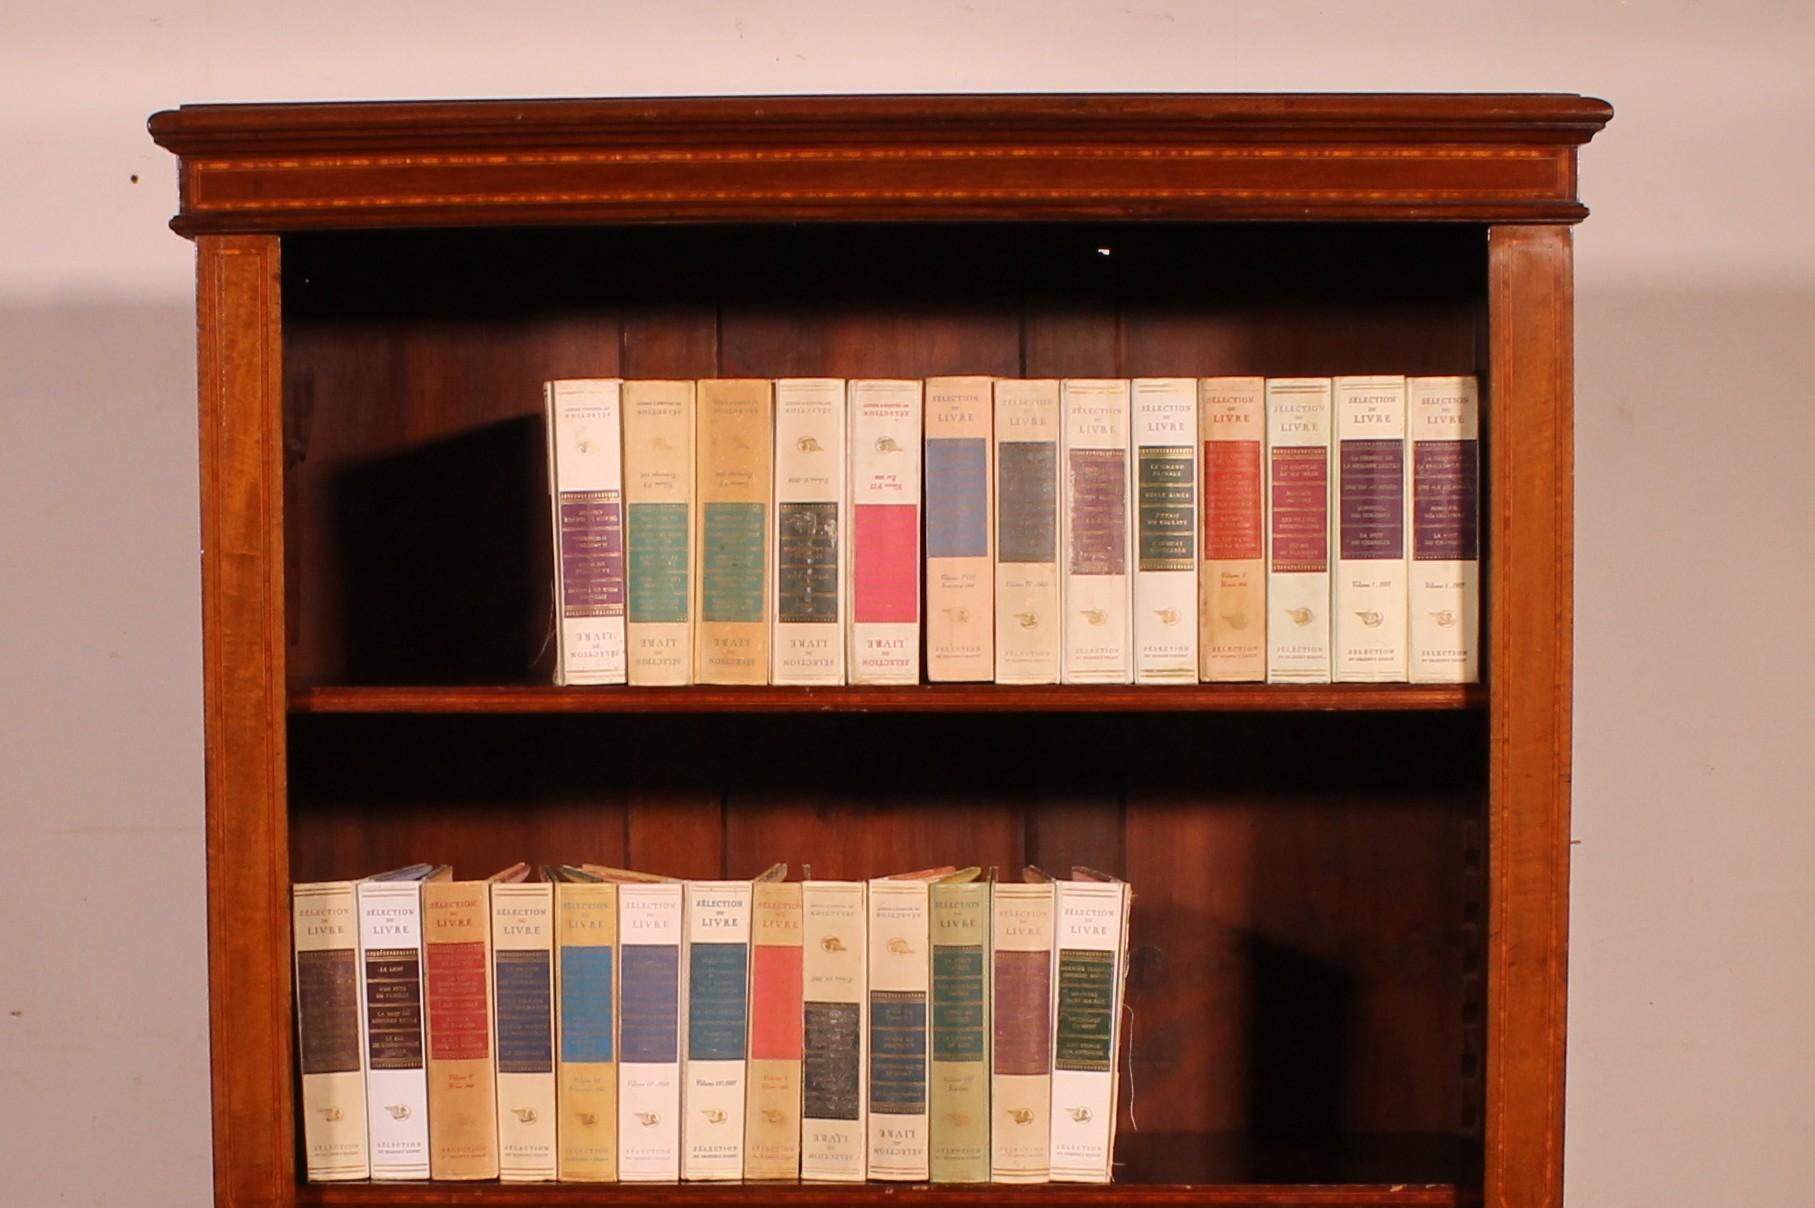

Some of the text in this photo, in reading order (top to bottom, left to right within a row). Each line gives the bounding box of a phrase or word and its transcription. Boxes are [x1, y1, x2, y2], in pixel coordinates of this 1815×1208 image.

[938, 414, 974, 422] LIVRE
[1213, 414, 1250, 423] LIVRE
[1353, 415, 1391, 423] LIVRE
[1427, 415, 1465, 424] LIVRE
[1080, 425, 1116, 434] LIVRE
[1148, 422, 1185, 431] LIVRE
[1280, 423, 1319, 432] LIVRE
[867, 639, 905, 649] LIVRE
[437, 919, 472, 928] LIVRE
[568, 921, 604, 929] LIVRE
[632, 920, 669, 929] LIVRE
[701, 918, 739, 927] LIVRE
[762, 920, 799, 929] LIVRE
[940, 919, 976, 928] LIVRE
[307, 926, 344, 936] LIVRE
[373, 926, 409, 935] LIVRE
[504, 927, 541, 935] LIVRE
[1006, 927, 1041, 936] LIVRE
[1071, 926, 1108, 935] LIVRE
[879, 1129, 916, 1138] LIVRE
[813, 1134, 848, 1143] LIVRE
